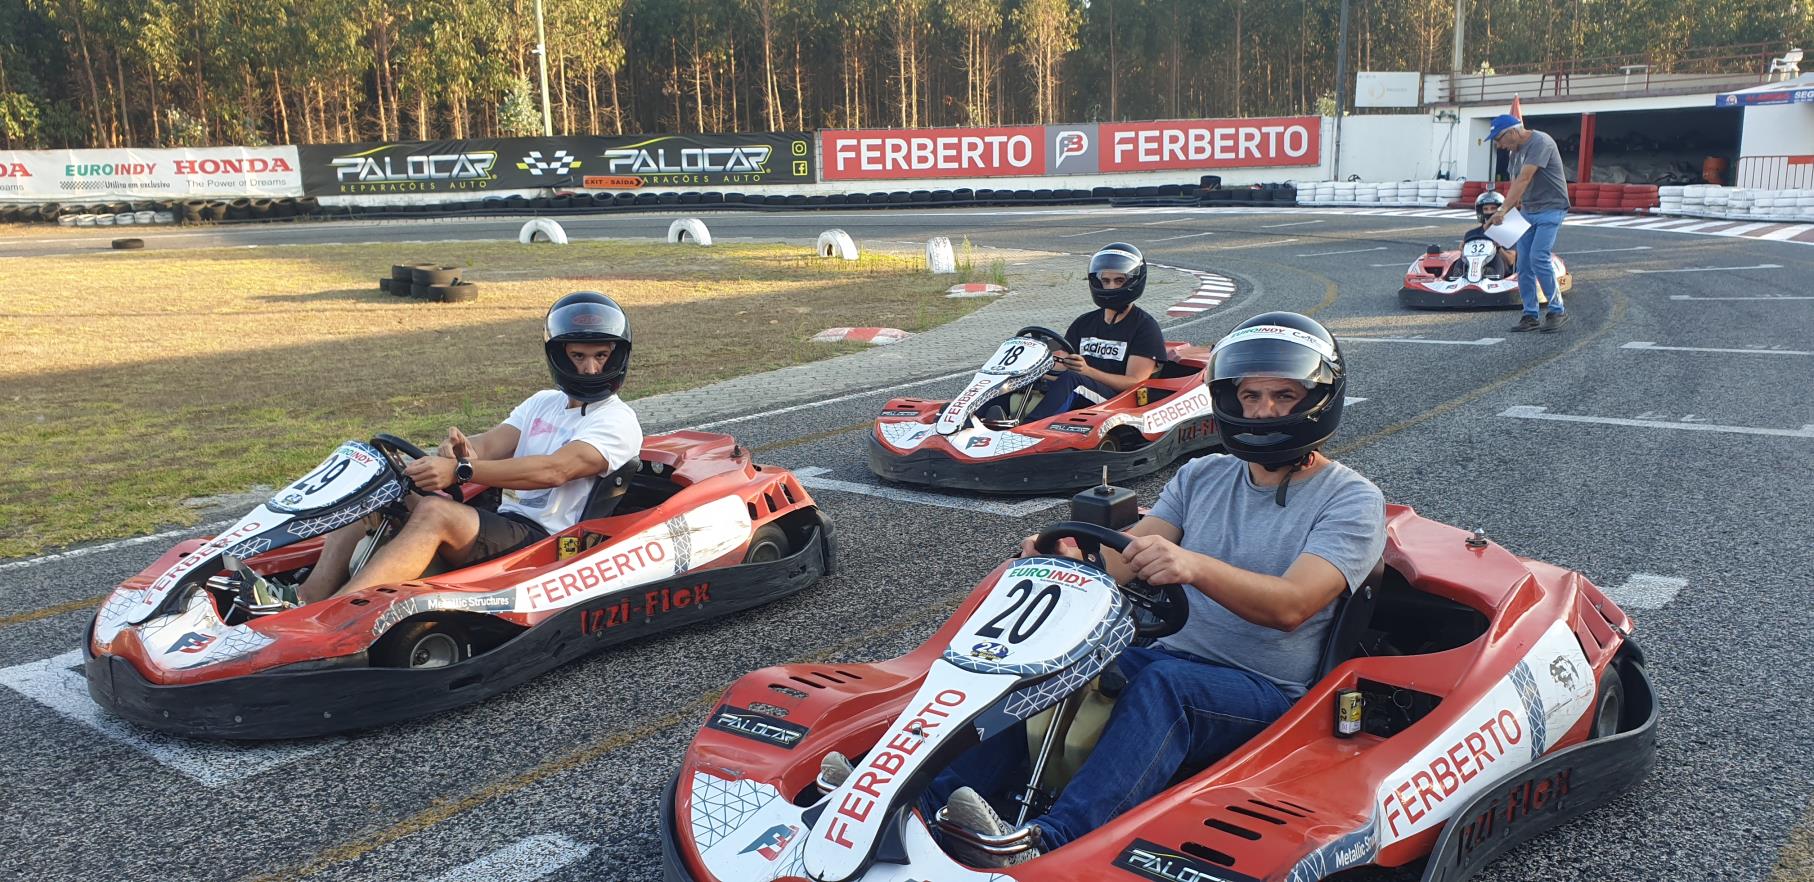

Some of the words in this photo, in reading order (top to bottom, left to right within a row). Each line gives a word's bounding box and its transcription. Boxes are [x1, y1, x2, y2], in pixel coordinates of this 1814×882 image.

[836, 134, 1033, 171] FERBERTO
[1114, 124, 1309, 164] FERBERTO
[65, 162, 157, 176] EUROINDY
[173, 157, 293, 175] HONDA
[331, 152, 497, 182] PALOCAR
[603, 146, 771, 174] PALOCAR
[186, 179, 204, 188] The
[207, 179, 235, 188] Power
[250, 178, 287, 187] Dreams
[450, 180, 487, 190] AUTO
[643, 174, 710, 185] ARAÇÕES
[723, 174, 761, 183] AUTO
[1471, 243, 1485, 254] 32
[998, 345, 1025, 366] 18
[1083, 338, 1119, 356] adidas
[944, 379, 991, 423] FERBERTO
[1146, 393, 1209, 431] FERBERTO
[292, 454, 351, 496] 29
[526, 540, 666, 609] FERBERTO
[1008, 567, 1094, 587] EUROINDY
[468, 596, 510, 608] Structures
[974, 578, 1062, 645] 20
[716, 711, 802, 745] PALOCAR
[824, 688, 967, 850] FERBERTO
[1382, 708, 1522, 838] FERBERTO
[1127, 848, 1228, 882] PALO
[1335, 841, 1366, 868] Metallic
